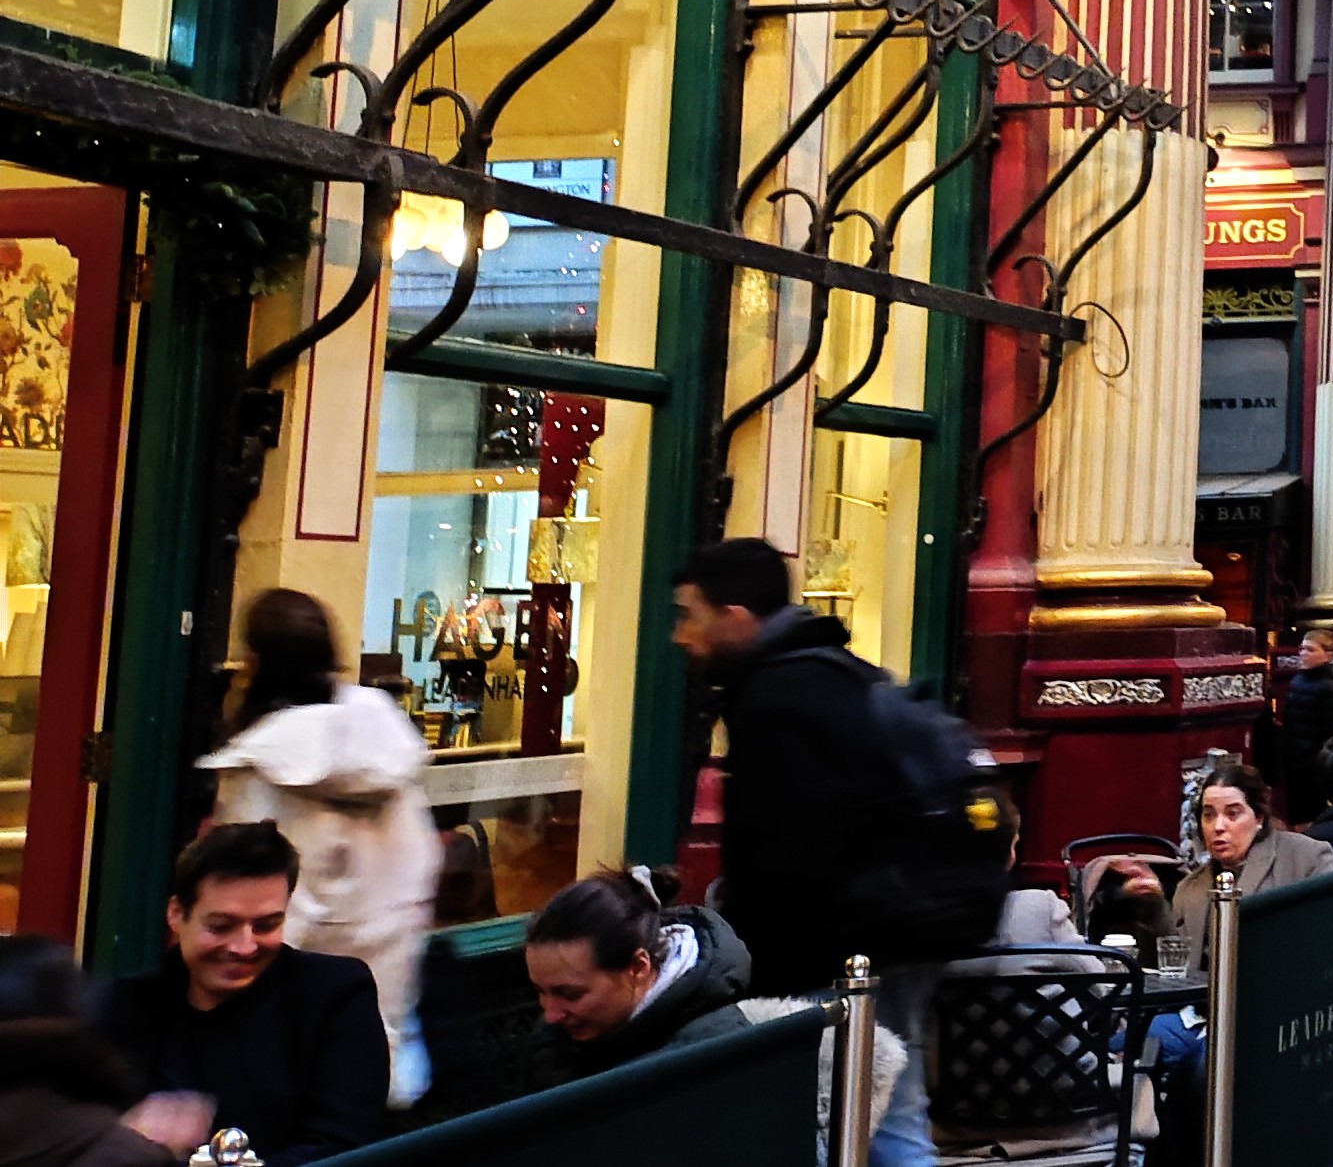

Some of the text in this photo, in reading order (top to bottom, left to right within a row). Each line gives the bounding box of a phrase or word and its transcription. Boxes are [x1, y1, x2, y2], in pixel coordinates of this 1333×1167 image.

[1241, 398, 1278, 409] BAR
[1217, 505, 1263, 522] BAR
[390, 597, 572, 662] HAGEN
